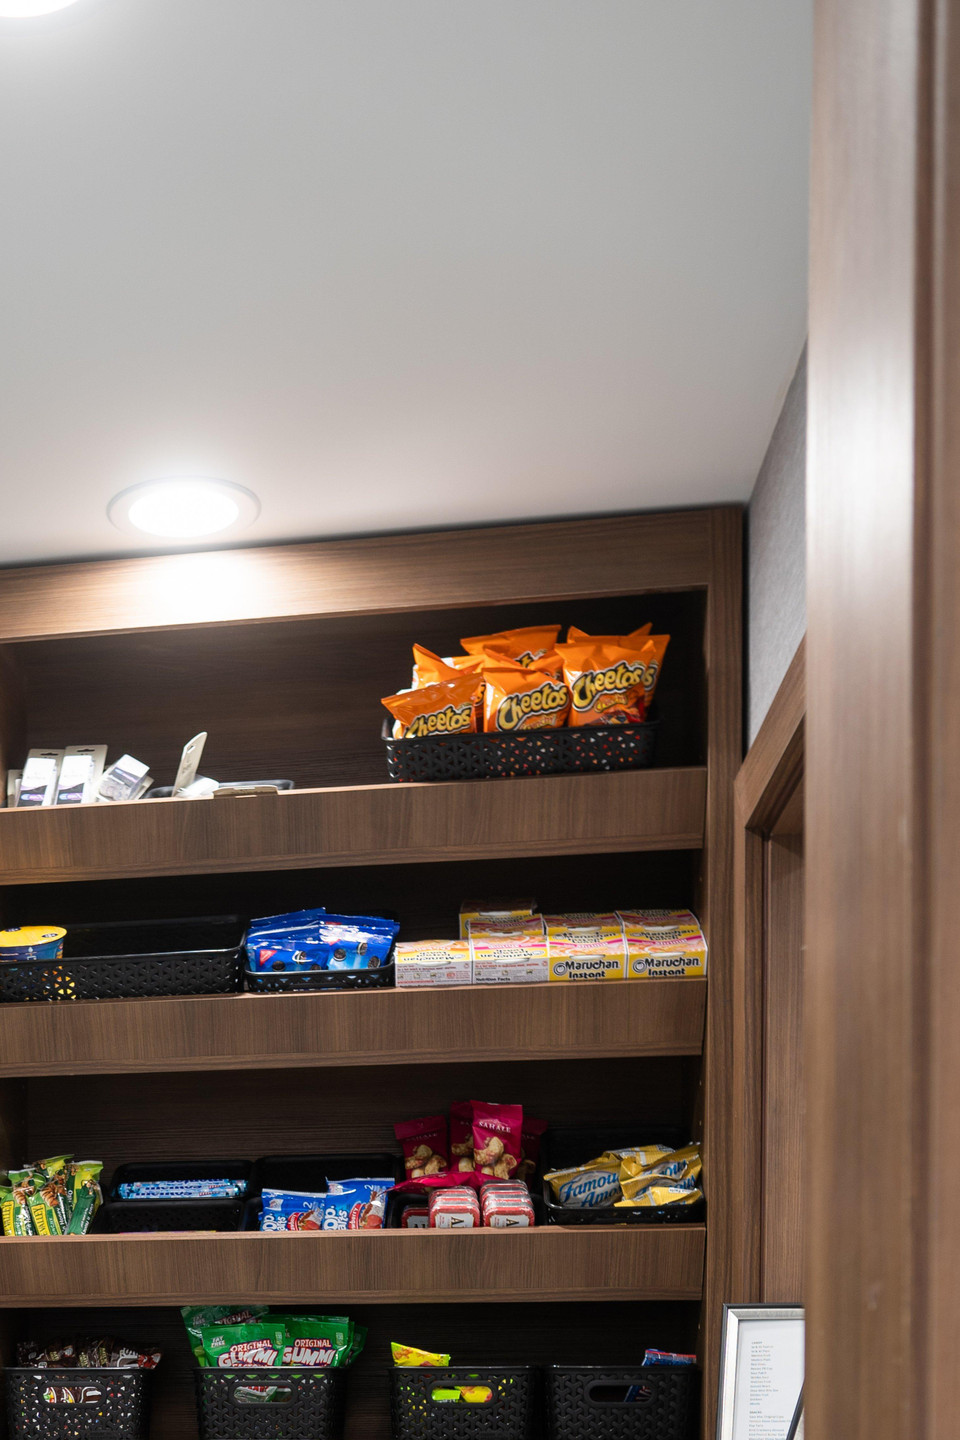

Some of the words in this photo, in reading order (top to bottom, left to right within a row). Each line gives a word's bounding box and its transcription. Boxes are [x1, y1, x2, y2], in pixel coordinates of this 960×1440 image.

[571, 659, 645, 711] Cheetos
[497, 683, 570, 731] Cheetos
[565, 959, 619, 971] Maruchan
[644, 956, 700, 968] Maruchan
[569, 970, 606, 979] Instant
[648, 968, 686, 977] Instant
[559, 1172, 620, 1203] Famou
[581, 1188, 621, 1207] Amo
[230, 1339, 273, 1354] ORIGINAL
[294, 1338, 332, 1348] ORIGINAL
[217, 1349, 279, 1367] GUMMI
[282, 1347, 337, 1366] GUMMI
